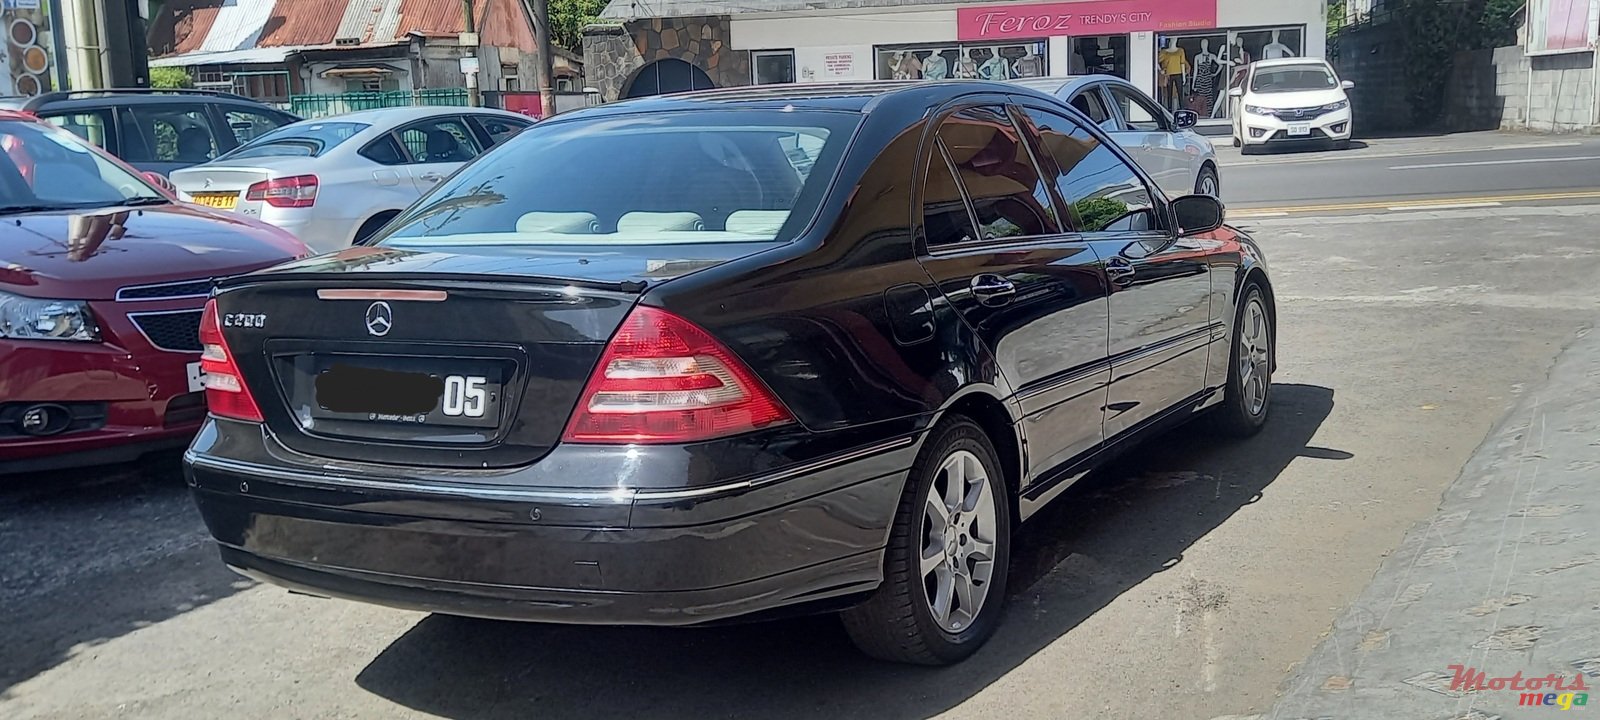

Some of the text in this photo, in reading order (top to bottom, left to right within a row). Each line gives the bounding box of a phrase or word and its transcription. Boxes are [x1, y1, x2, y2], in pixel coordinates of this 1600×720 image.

[975, 11, 1152, 36] Feroz TRENDY'S CITY
[1159, 19, 1212, 29] Fashion Studio
[224, 313, 267, 328] C200
[442, 375, 487, 417] 05
